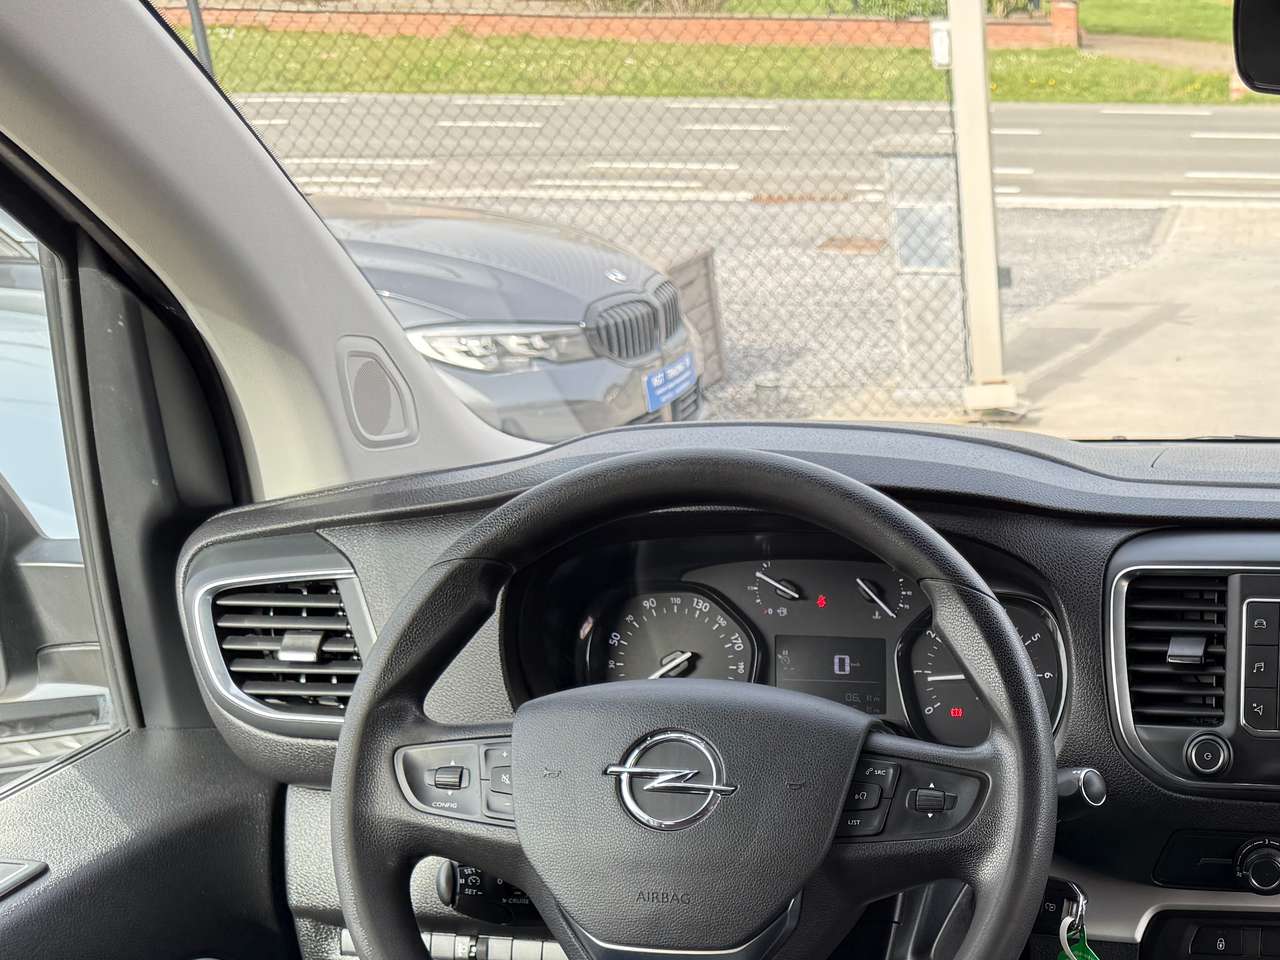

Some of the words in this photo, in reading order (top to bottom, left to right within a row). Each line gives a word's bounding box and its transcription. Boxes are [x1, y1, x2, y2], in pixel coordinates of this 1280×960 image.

[642, 598, 657, 609] 90
[692, 598, 710, 611] 130
[608, 632, 621, 647] 50
[926, 630, 936, 639] 2
[1031, 632, 1041, 642] 5
[730, 632, 744, 651] 170
[833, 655, 850, 675] 0
[924, 706, 934, 715] 0
[431, 801, 458, 809] CONFIG
[636, 891, 691, 905] AIRBAG
